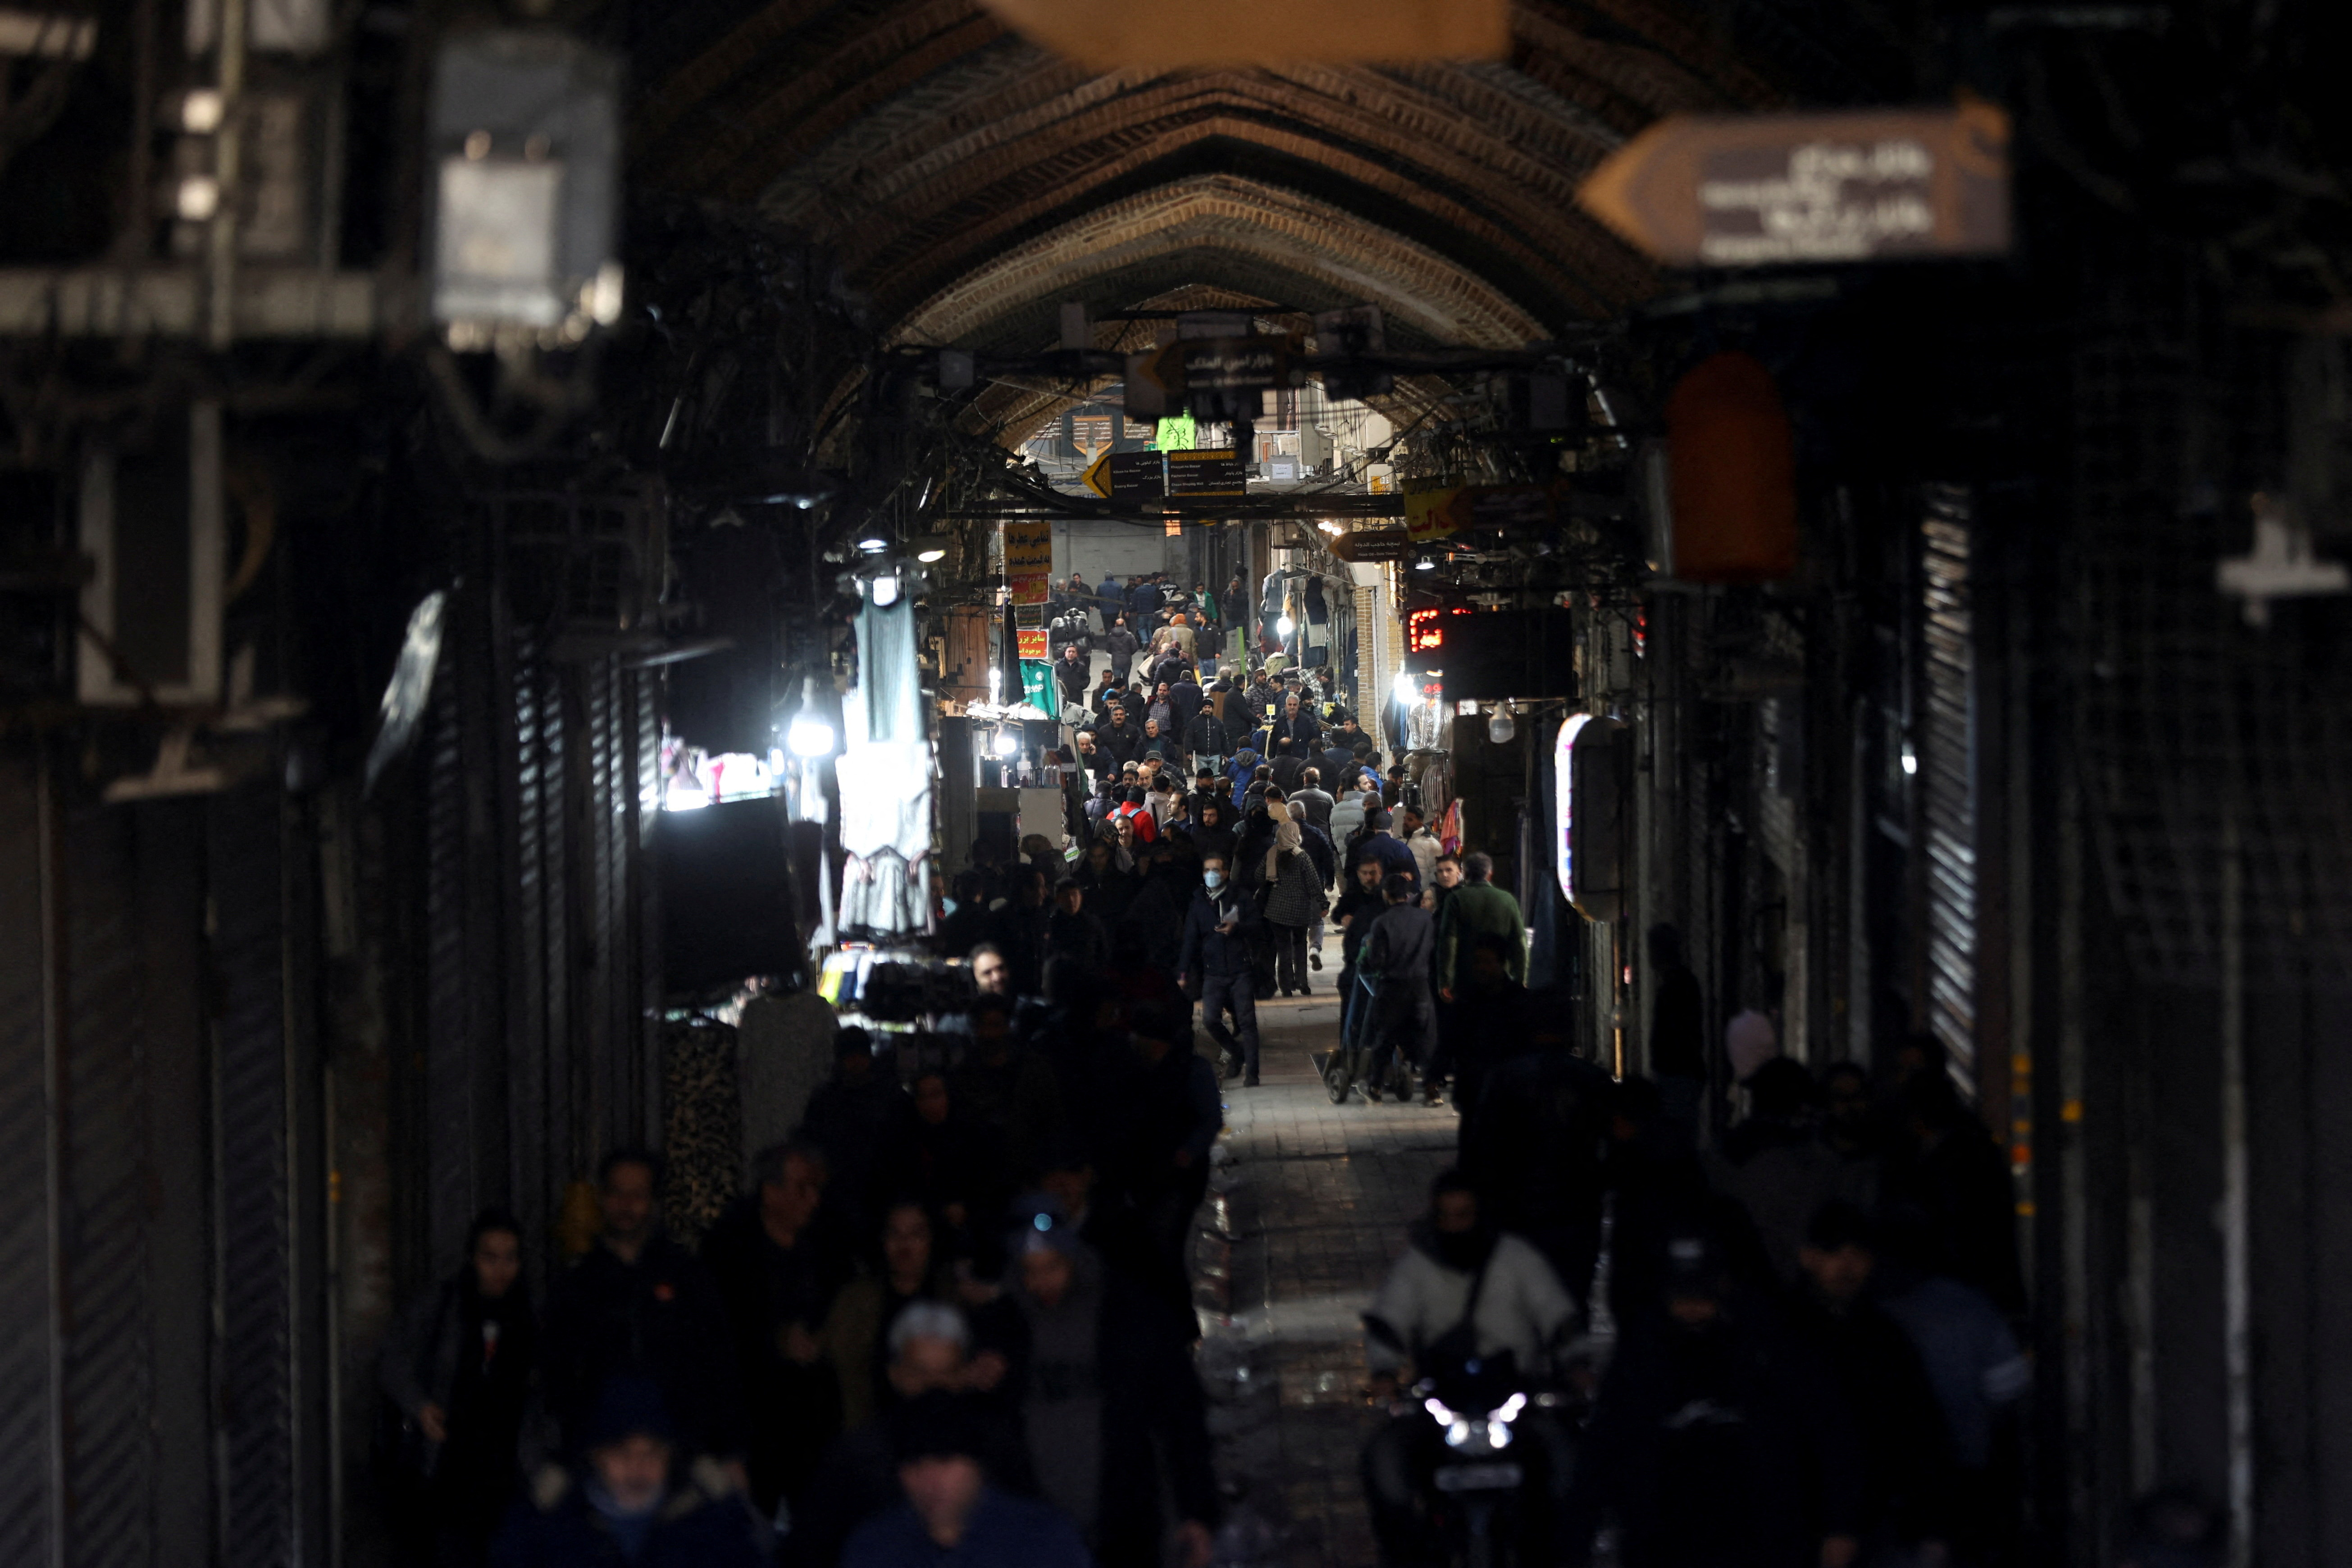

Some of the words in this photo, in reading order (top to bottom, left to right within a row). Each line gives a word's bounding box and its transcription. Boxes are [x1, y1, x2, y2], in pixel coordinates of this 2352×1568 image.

[1009, 556, 1025, 567] عمده
[1026, 552, 1043, 567] قیمت
[1016, 634, 1029, 644] بزر
[1030, 634, 1045, 644] سایز
